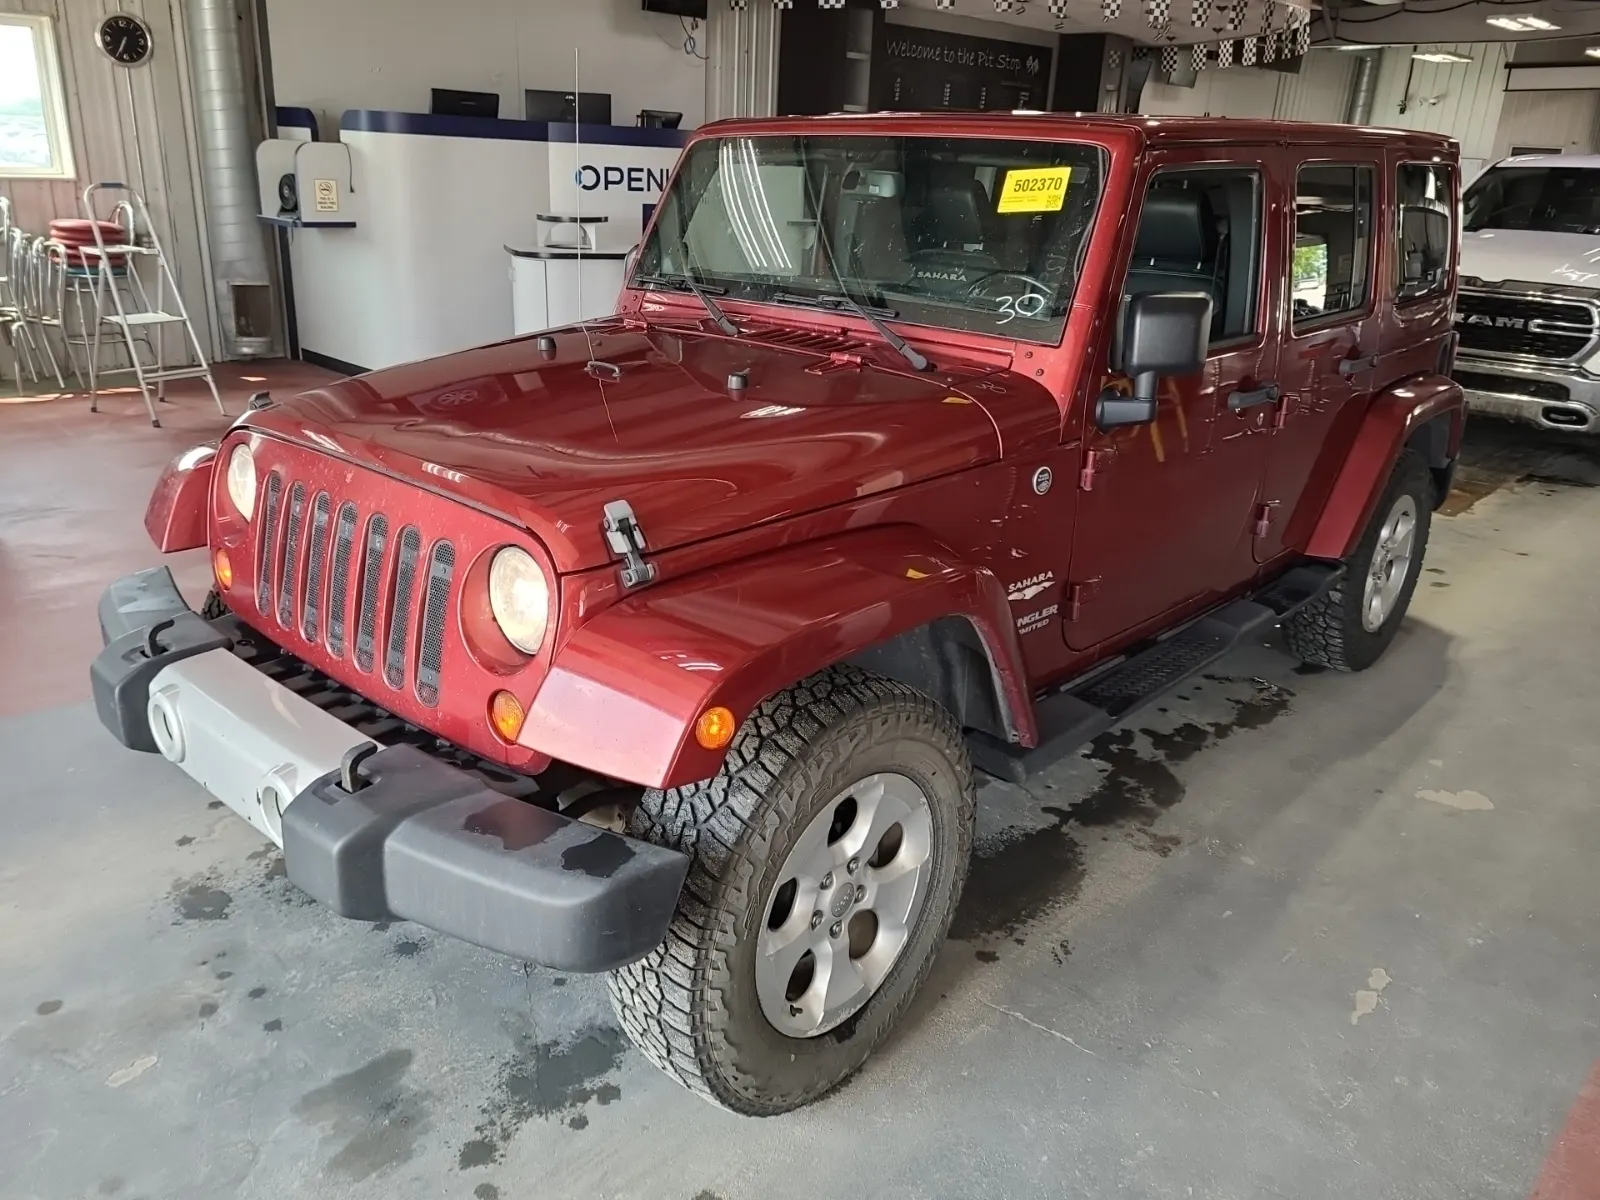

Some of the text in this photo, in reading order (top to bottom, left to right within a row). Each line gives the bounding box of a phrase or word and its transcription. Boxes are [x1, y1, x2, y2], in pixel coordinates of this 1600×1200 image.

[886, 38, 1021, 75] Welcome to the Pit Stop
[1013, 177, 1063, 192] 502370
[917, 271, 967, 282] SAHARA
[996, 293, 1045, 324] 30
[1008, 570, 1054, 593] SAHARA
[1015, 604, 1058, 628] NGLER
